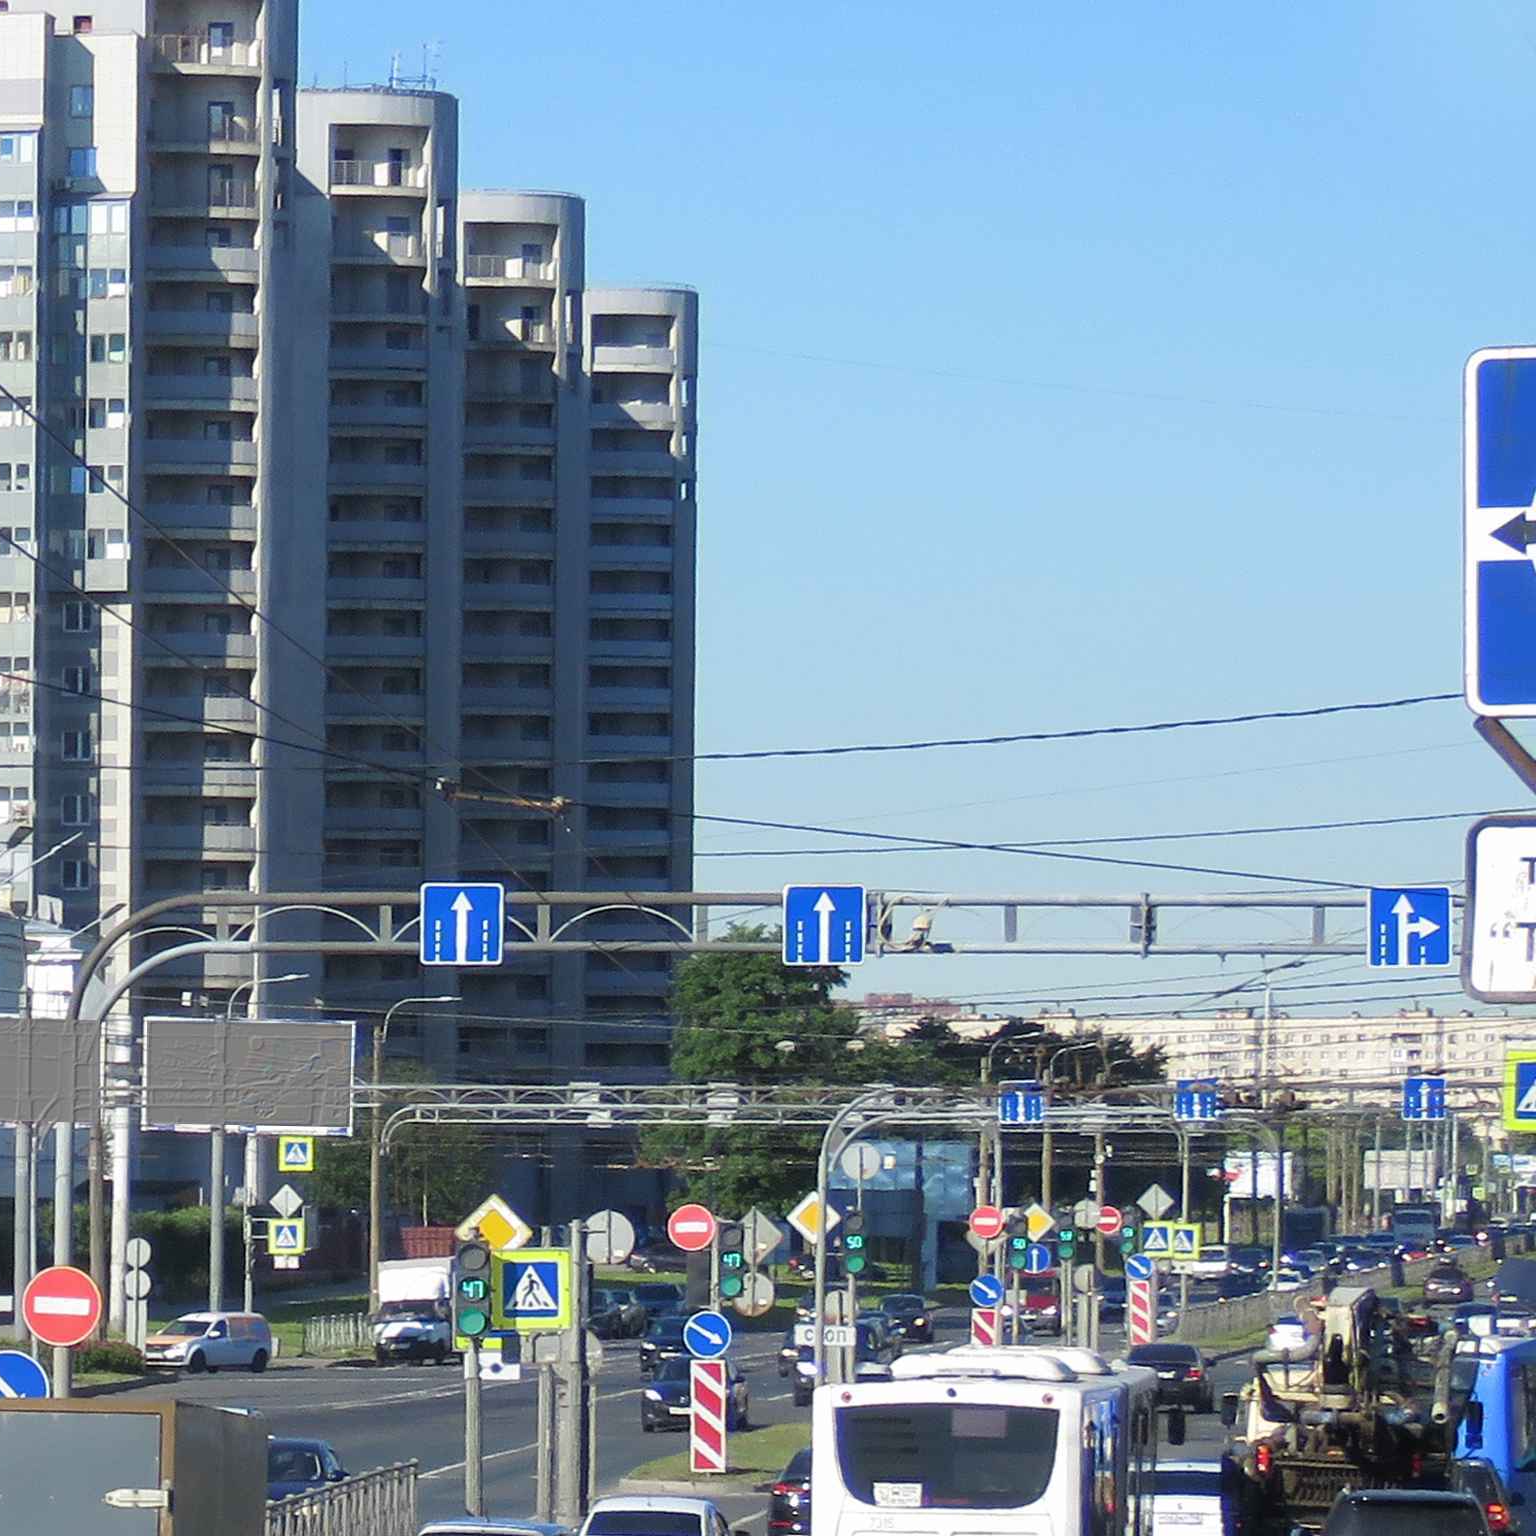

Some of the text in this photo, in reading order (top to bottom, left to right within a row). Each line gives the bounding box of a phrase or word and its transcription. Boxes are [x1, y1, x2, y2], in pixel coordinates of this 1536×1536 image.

[846, 1235, 862, 1249] 50
[722, 1253, 741, 1268] 47
[461, 1280, 484, 1298] 47
[804, 1328, 847, 1342] СОП
